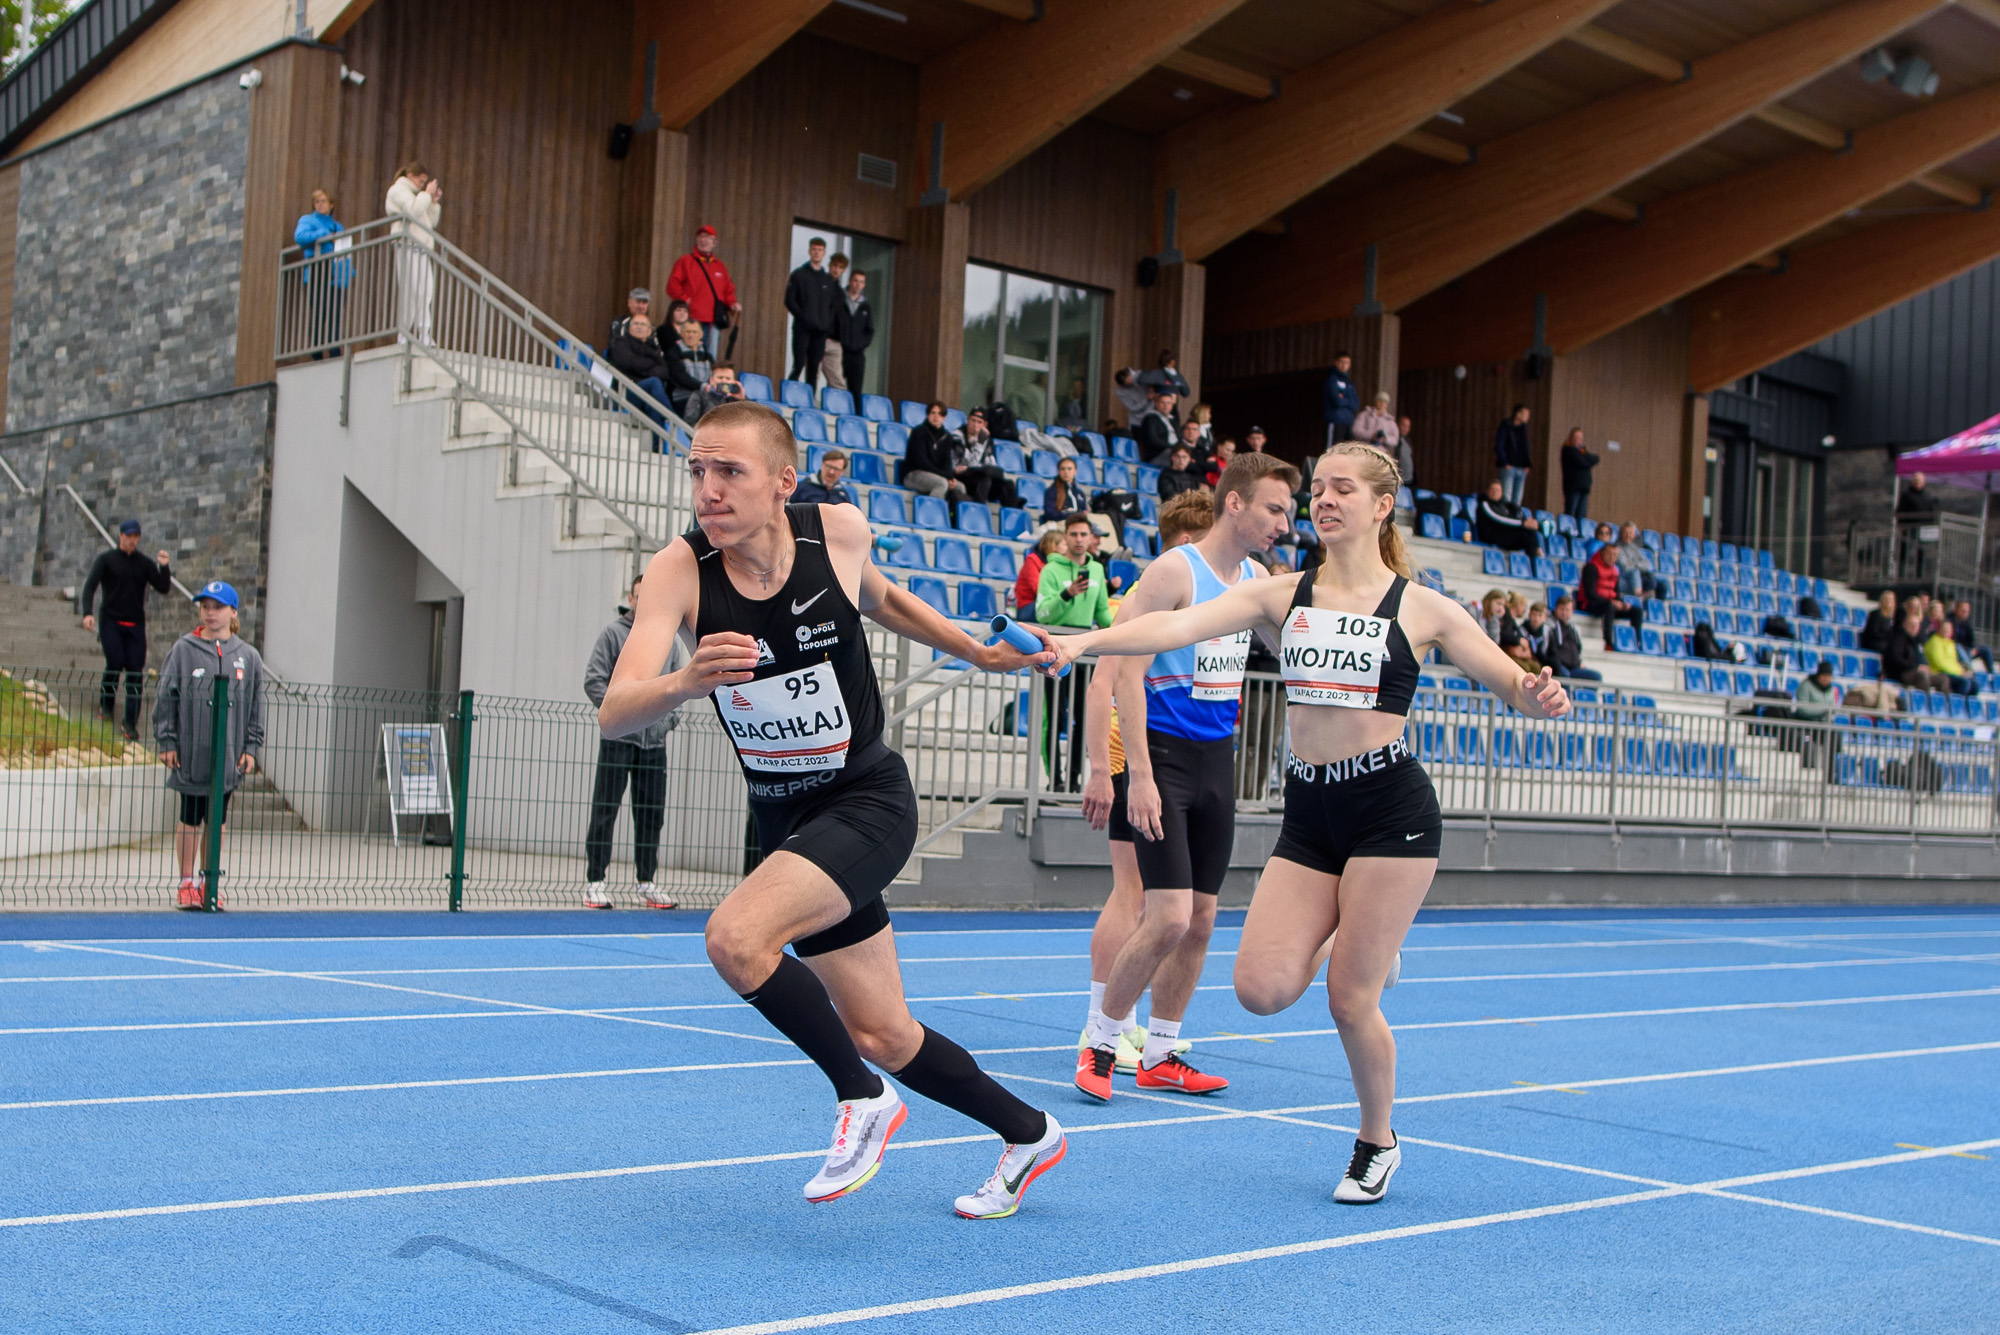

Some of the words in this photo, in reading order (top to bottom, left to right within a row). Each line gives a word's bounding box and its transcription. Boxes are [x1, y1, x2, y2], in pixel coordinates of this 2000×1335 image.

[812, 623, 836, 635] OPOLE
[1336, 616, 1382, 638] 103
[803, 636, 839, 650] OPOLSKIE
[1284, 647, 1372, 672] WOJTAS
[784, 671, 820, 701] 95
[1326, 691, 1350, 700] 2022
[729, 705, 843, 740] BACHŁAJ
[756, 757, 802, 768] KARPACZ
[804, 756, 830, 767] 2022
[1288, 752, 1316, 783] PRO
[1325, 748, 1386, 784] NIKE
[749, 783, 786, 797] NIKE
[787, 769, 837, 796] PRO
